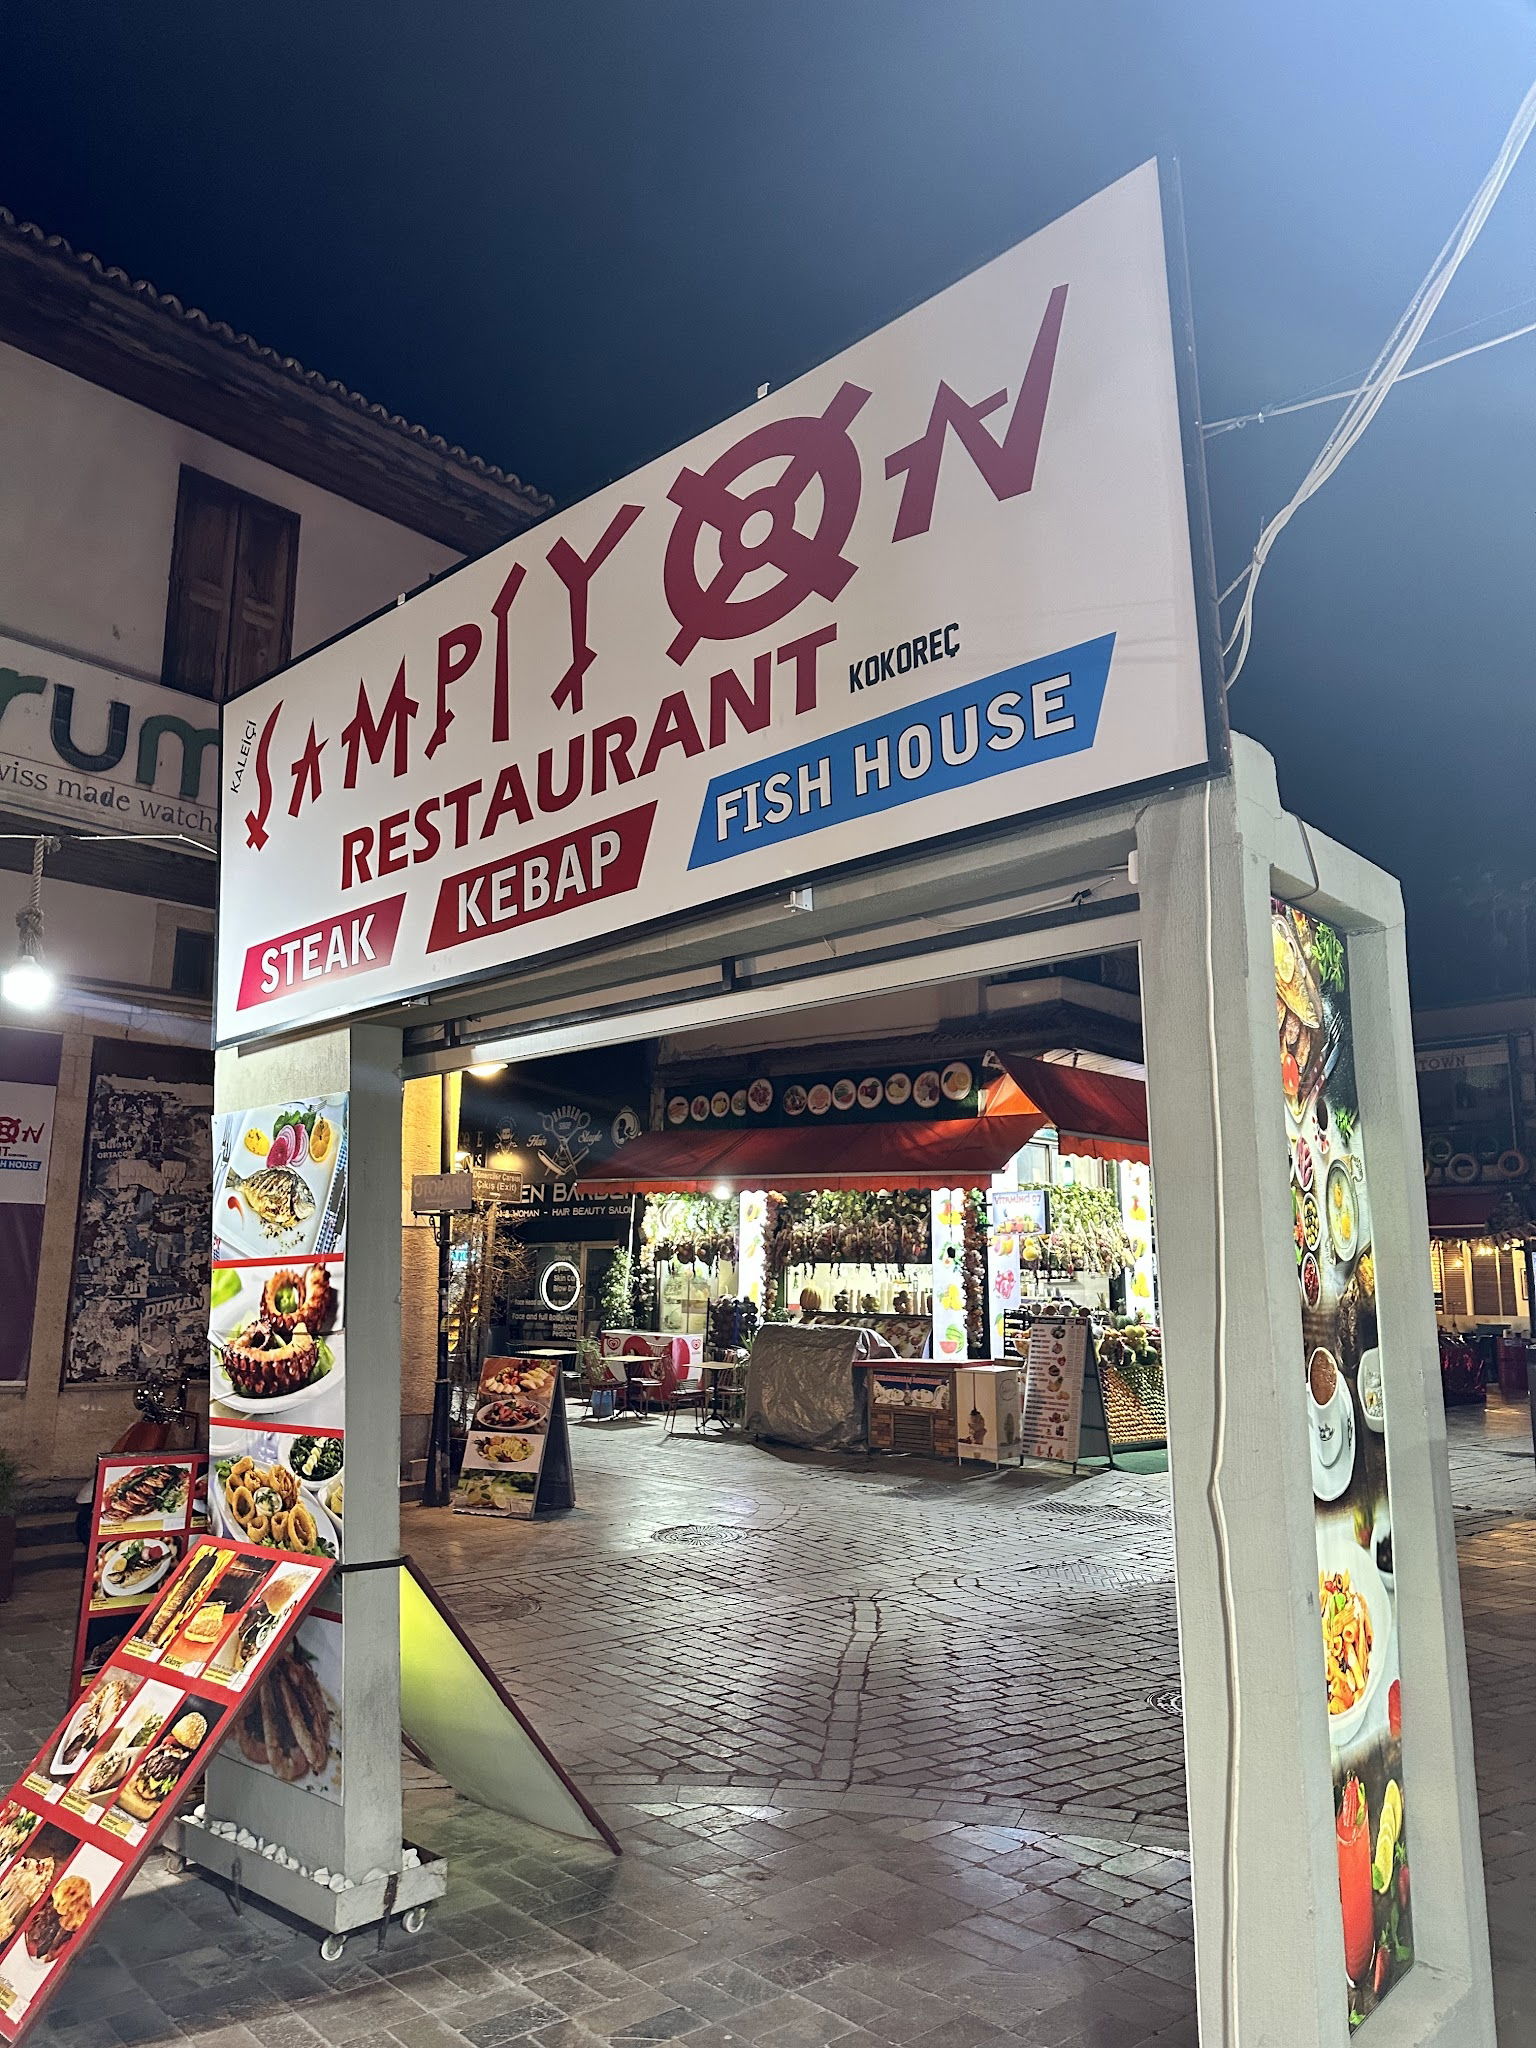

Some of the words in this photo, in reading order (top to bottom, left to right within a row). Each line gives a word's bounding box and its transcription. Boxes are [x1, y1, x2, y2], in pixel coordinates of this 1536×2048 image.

[849, 621, 961, 693] KOKOREÇ
[230, 719, 257, 794] KALEİÇİ
[341, 622, 838, 891] RESTAURANT
[716, 755, 832, 843] FISH
[853, 671, 1077, 797] HOUSE
[58, 777, 131, 812] made
[457, 829, 623, 934] KEBAP
[259, 912, 378, 994] STEAK
[8, 1161, 39, 1170] HOUSE
[413, 1179, 470, 1197] OTOPARK
[496, 1182, 517, 1192] (Exit)
[552, 1208, 570, 1217] HAIR
[573, 1207, 605, 1216] BEAUTY
[144, 1296, 204, 1319] DUMAN
